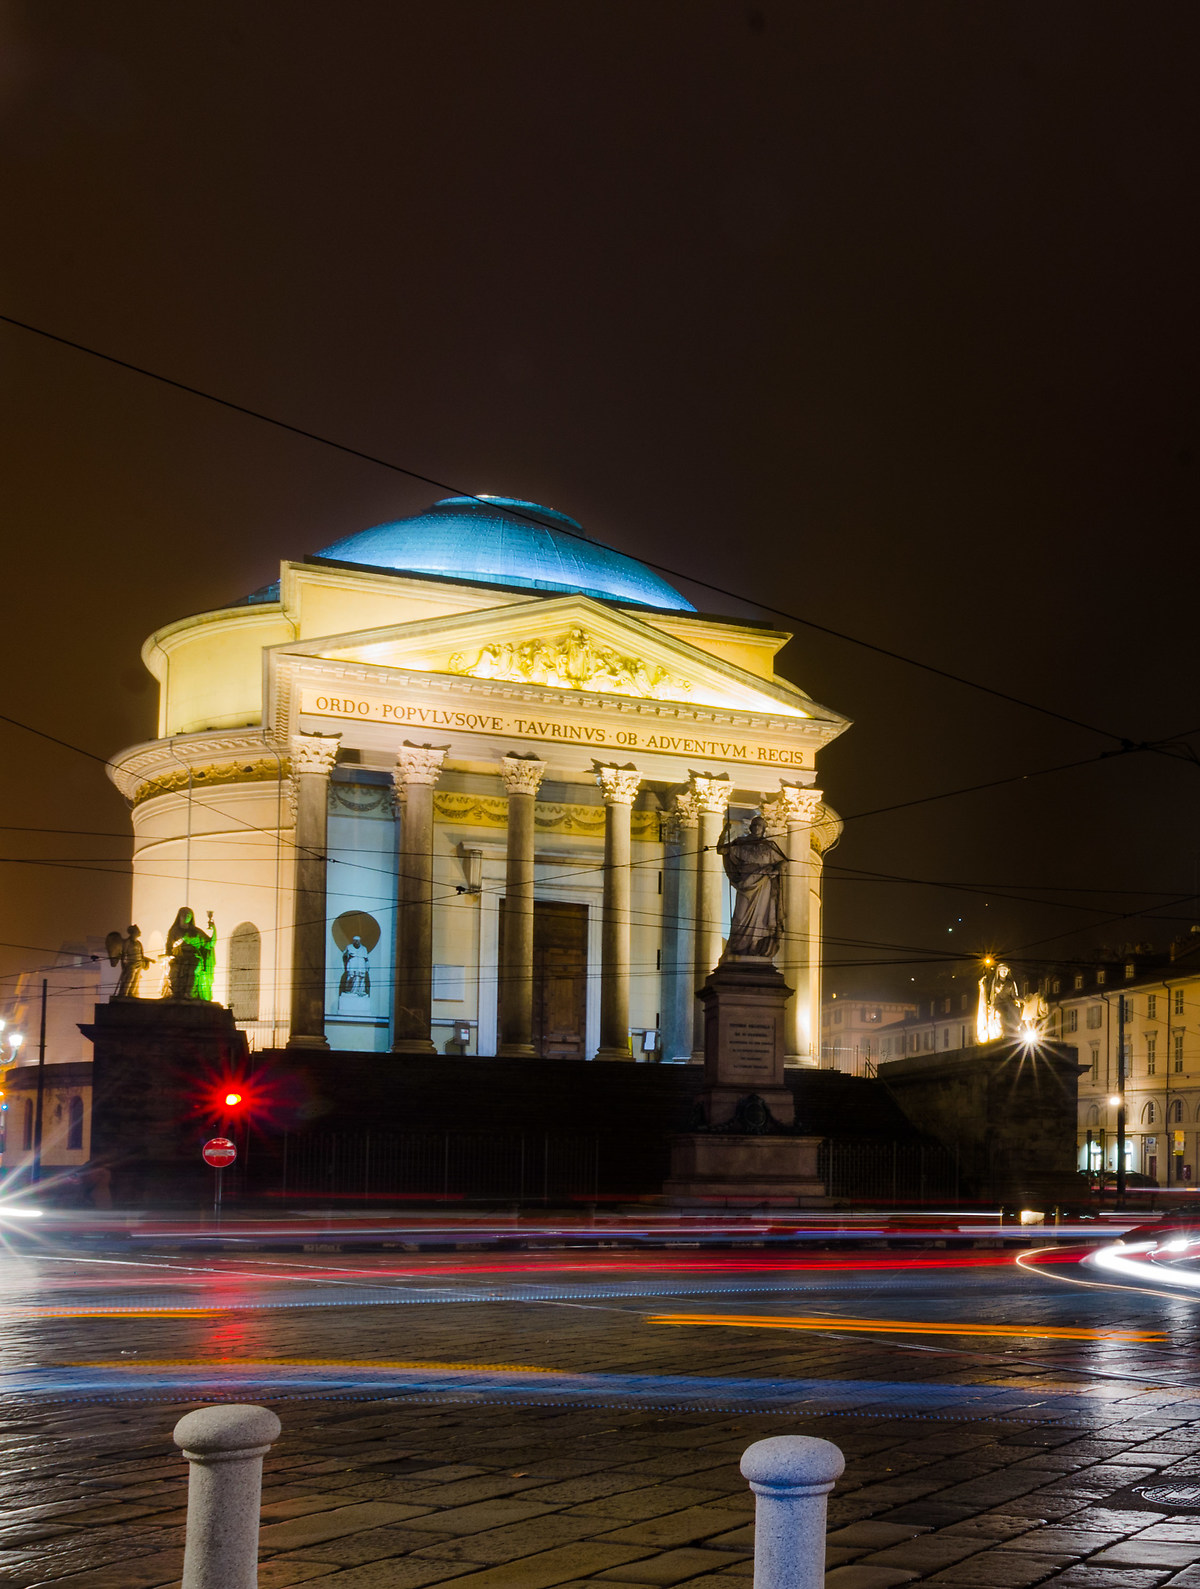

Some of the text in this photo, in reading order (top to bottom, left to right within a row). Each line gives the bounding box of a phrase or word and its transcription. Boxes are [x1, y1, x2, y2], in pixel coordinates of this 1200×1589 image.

[316, 696, 804, 764] ORDO POPVLVSQVE TAVRINVS OB ADVENTVM REGIS
